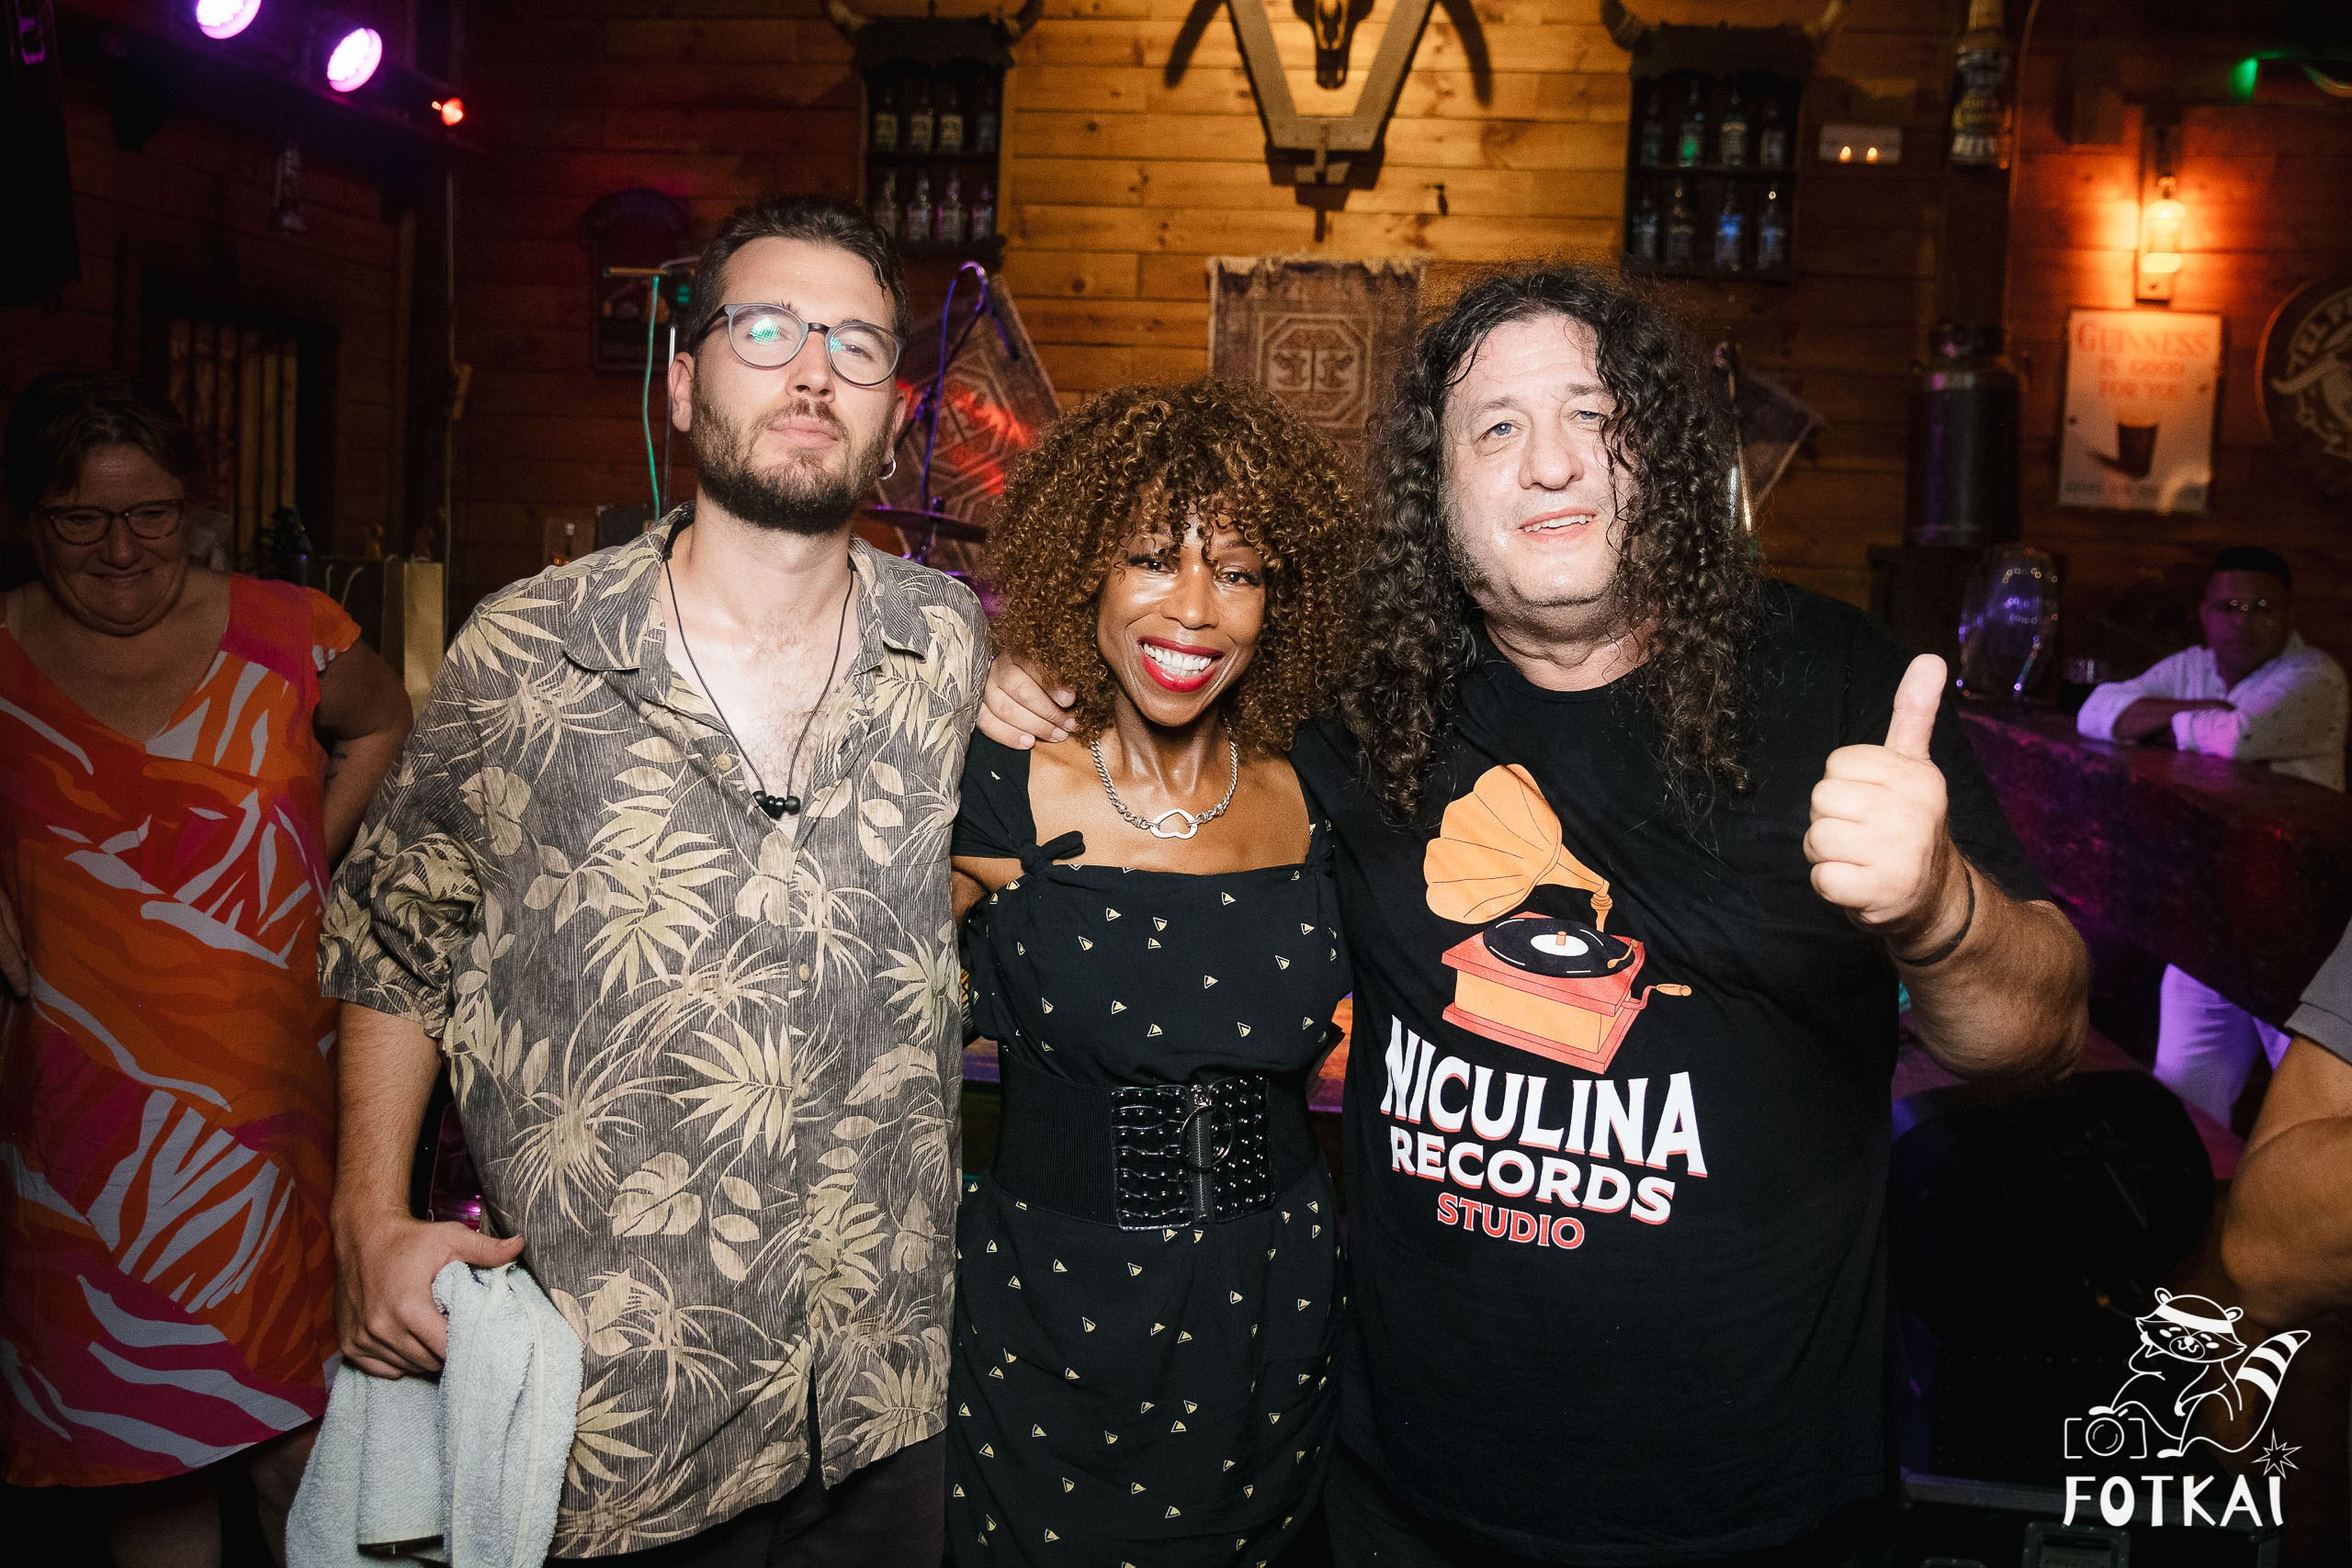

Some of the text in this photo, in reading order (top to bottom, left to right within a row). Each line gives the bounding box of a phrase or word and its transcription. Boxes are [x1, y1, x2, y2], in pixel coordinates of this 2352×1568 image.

[2076, 321, 2209, 356] GUINNESS
[1380, 1014, 1708, 1179] NICULINA
[1390, 1125, 1676, 1225] RECORDS
[1437, 1191, 1586, 1250] STUDIO
